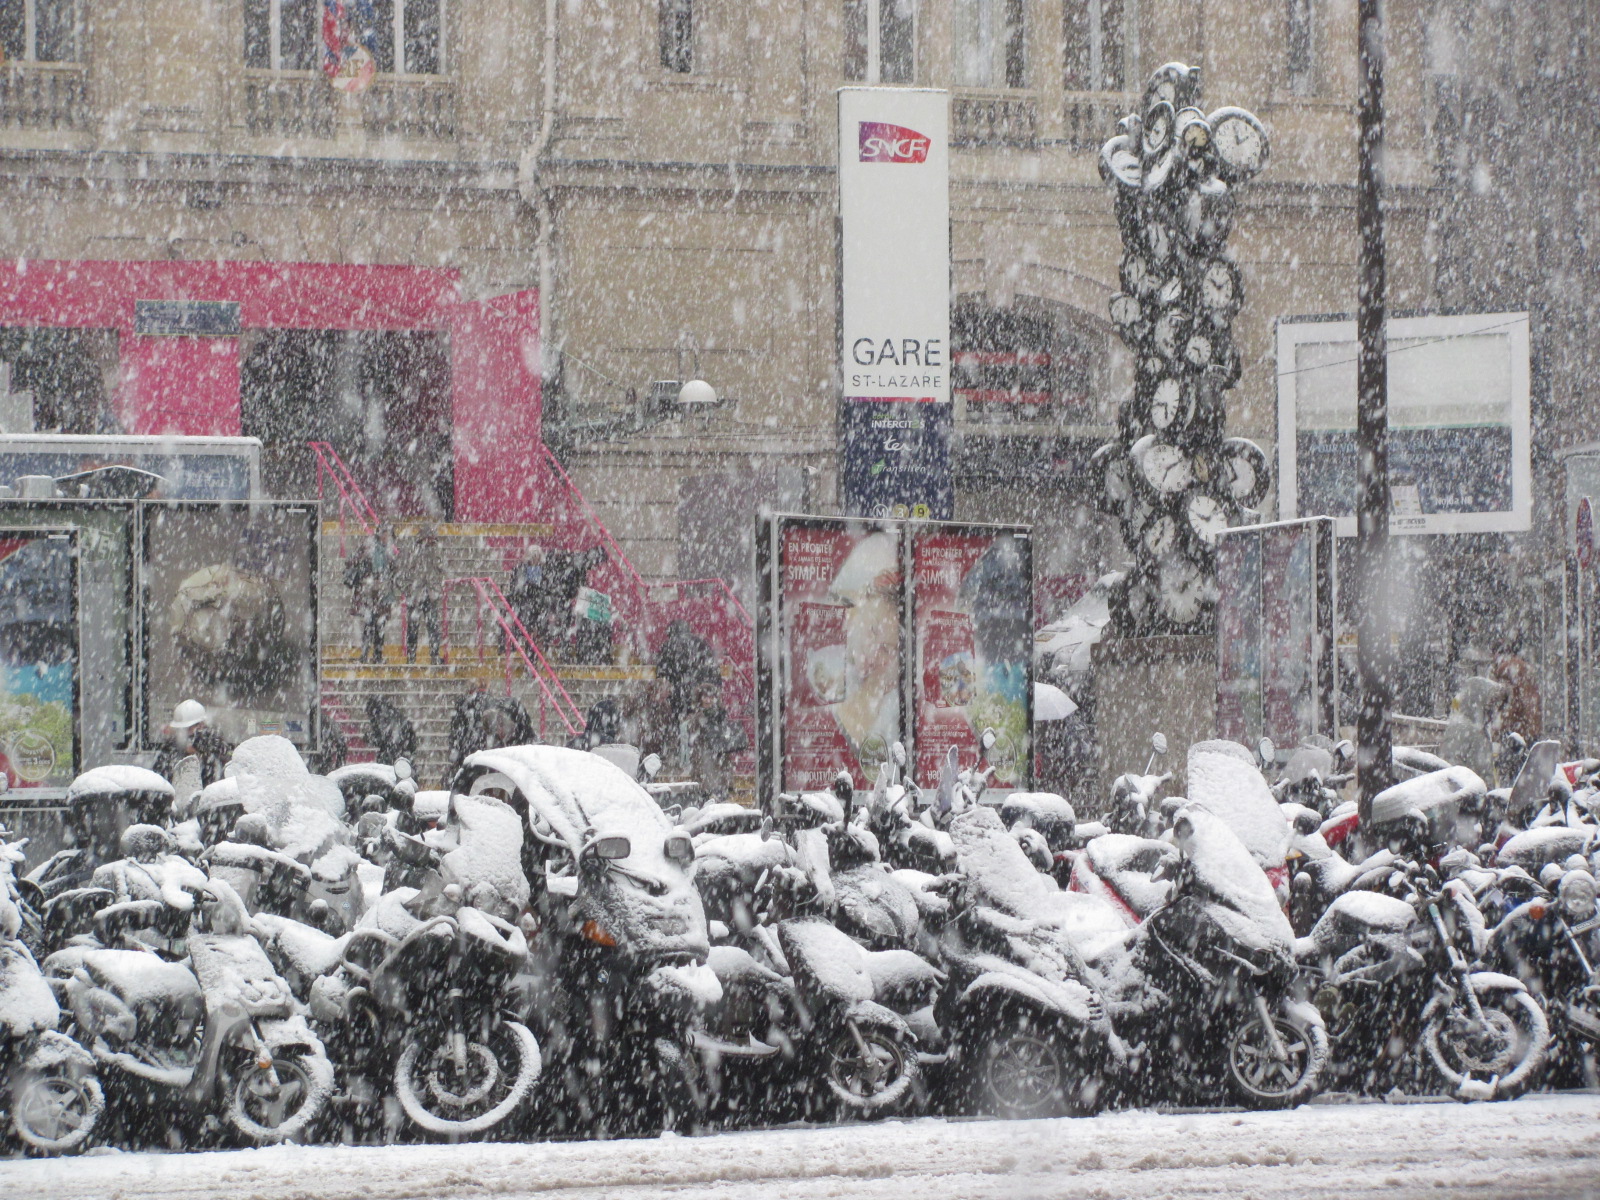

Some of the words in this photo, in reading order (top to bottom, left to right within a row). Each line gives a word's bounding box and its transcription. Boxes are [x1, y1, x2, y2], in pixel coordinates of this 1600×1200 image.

[862, 138, 927, 158] SNCF
[852, 337, 941, 366] GARE
[852, 374, 943, 388] ST-LAZARE
[882, 434, 912, 451] ter
[875, 464, 927, 474] Transilien
[788, 542, 799, 553] EN
[788, 564, 827, 581] SIMPLE
